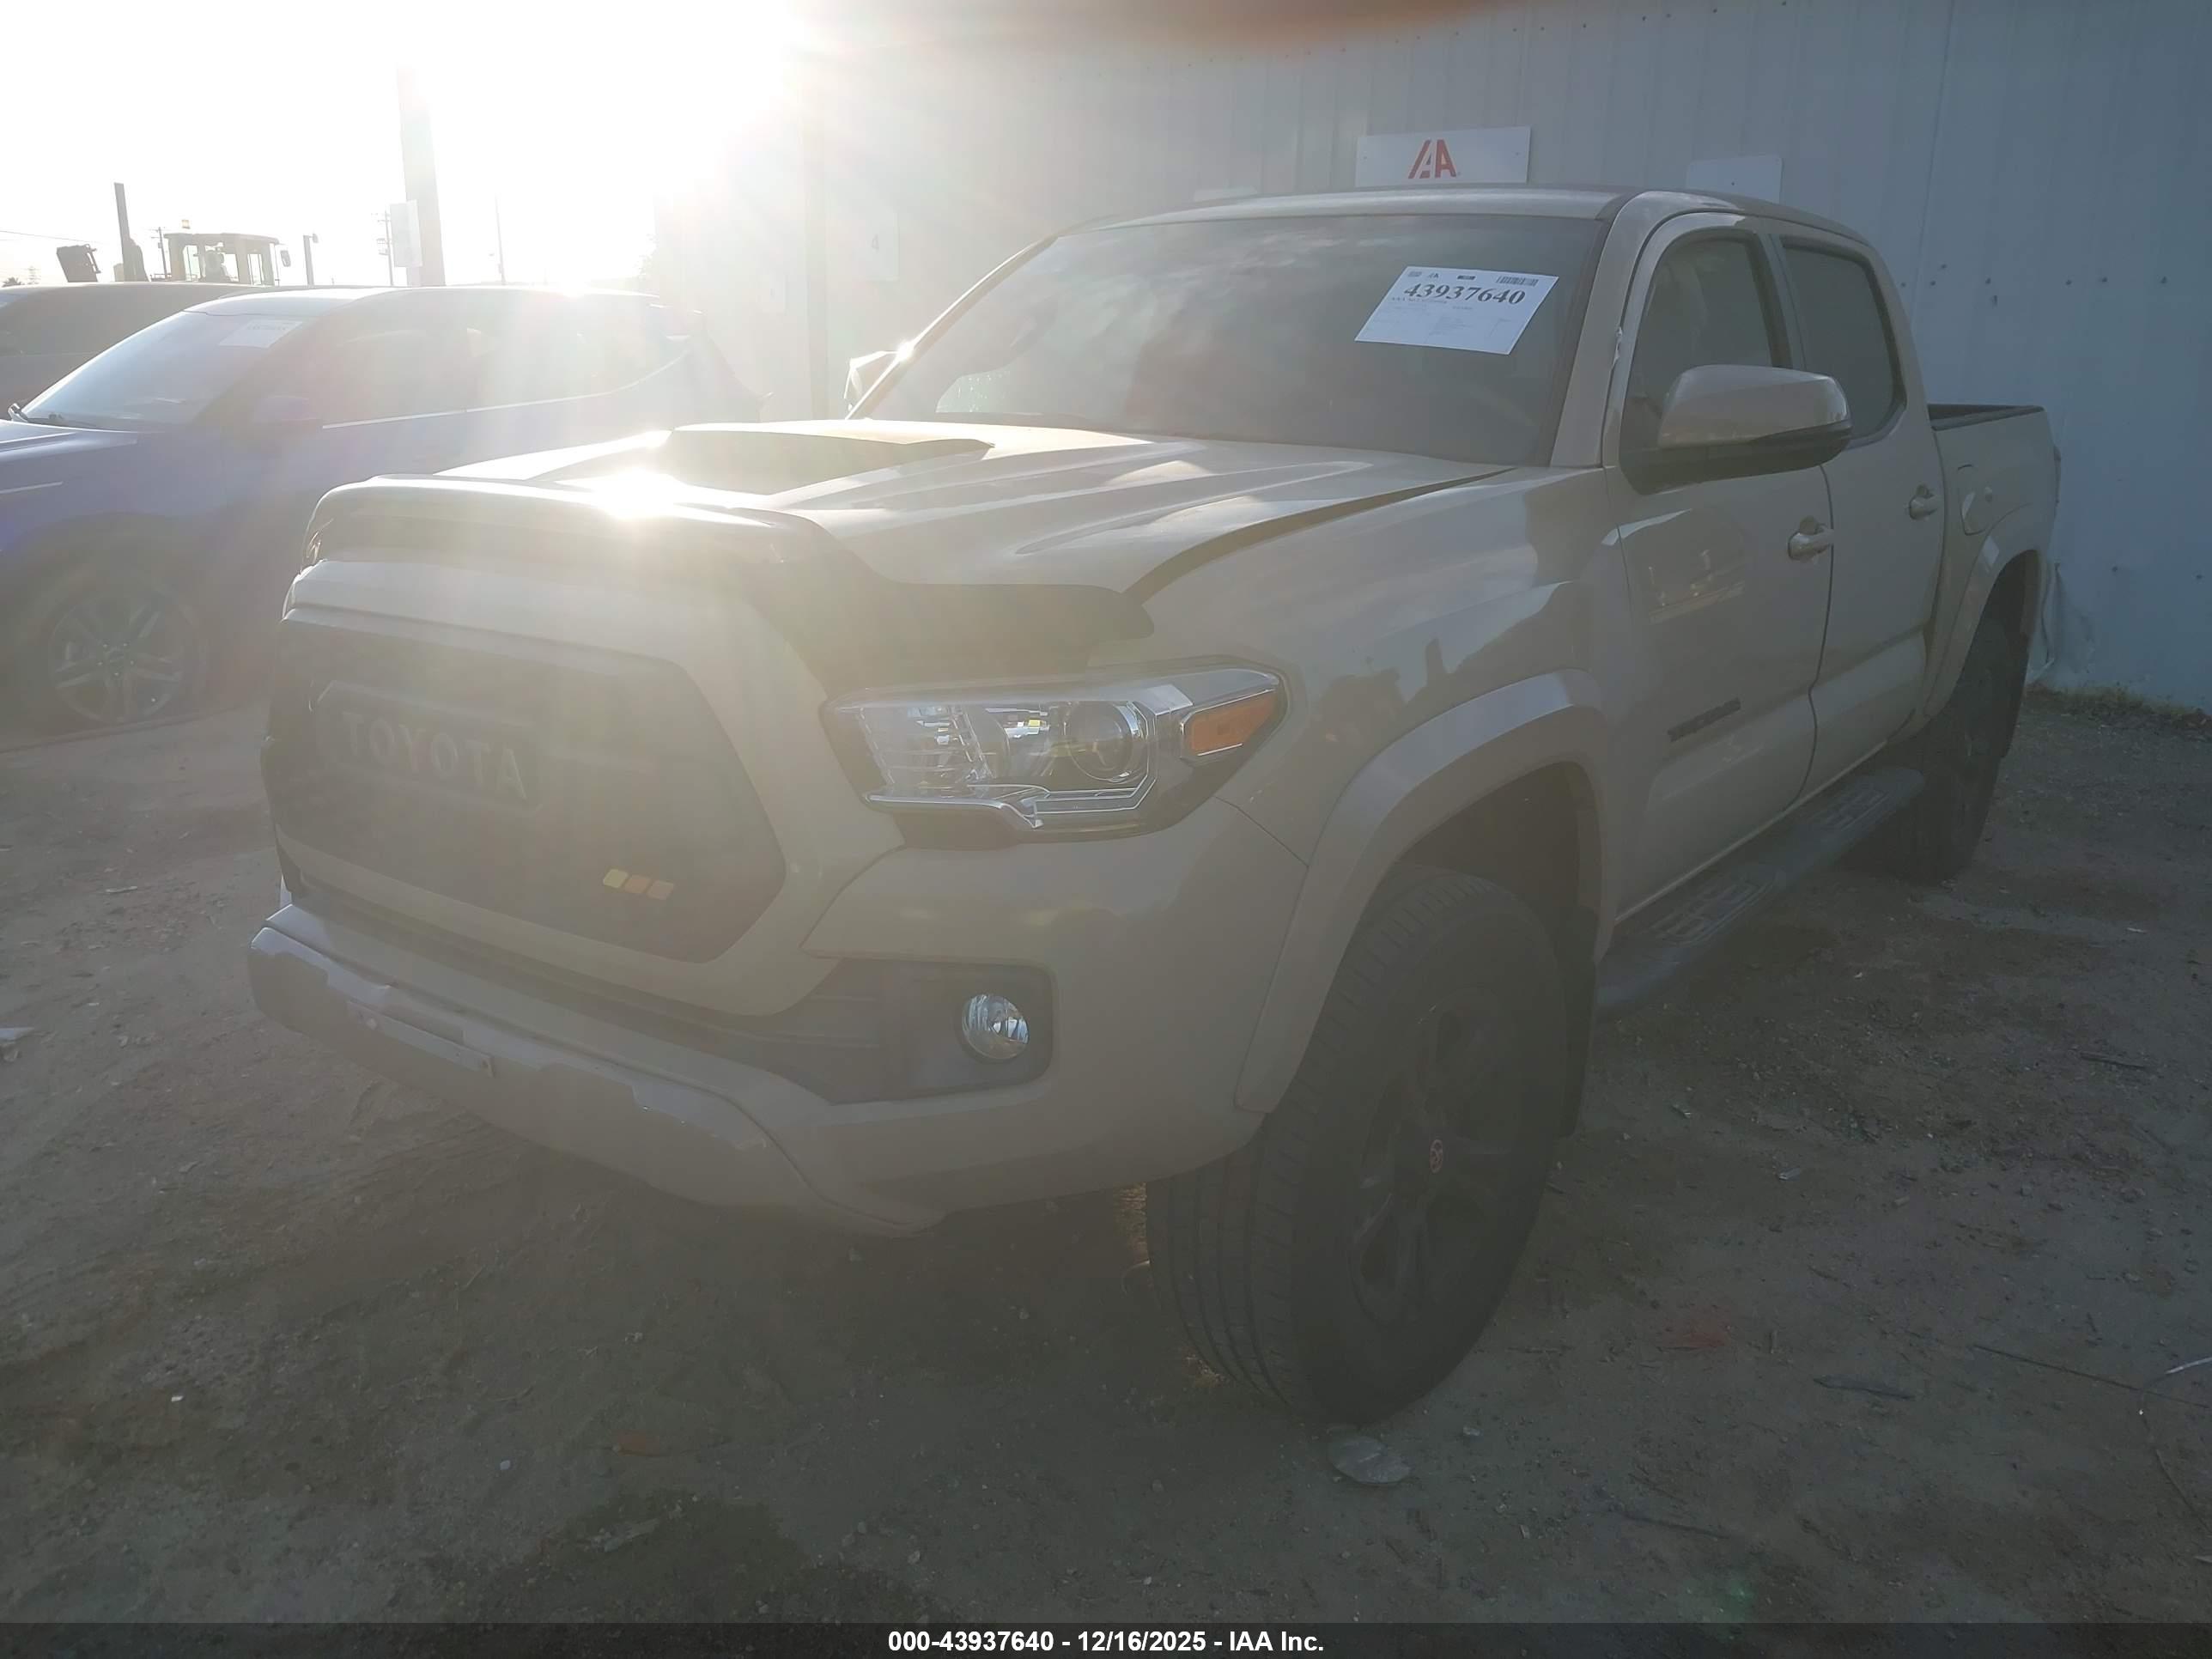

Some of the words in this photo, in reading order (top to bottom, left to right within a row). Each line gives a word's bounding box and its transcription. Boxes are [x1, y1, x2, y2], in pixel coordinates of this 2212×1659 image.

[1408, 139, 1457, 179] IAA
[1404, 283, 1526, 305] 43937640
[341, 709, 528, 802] TOYOTA
